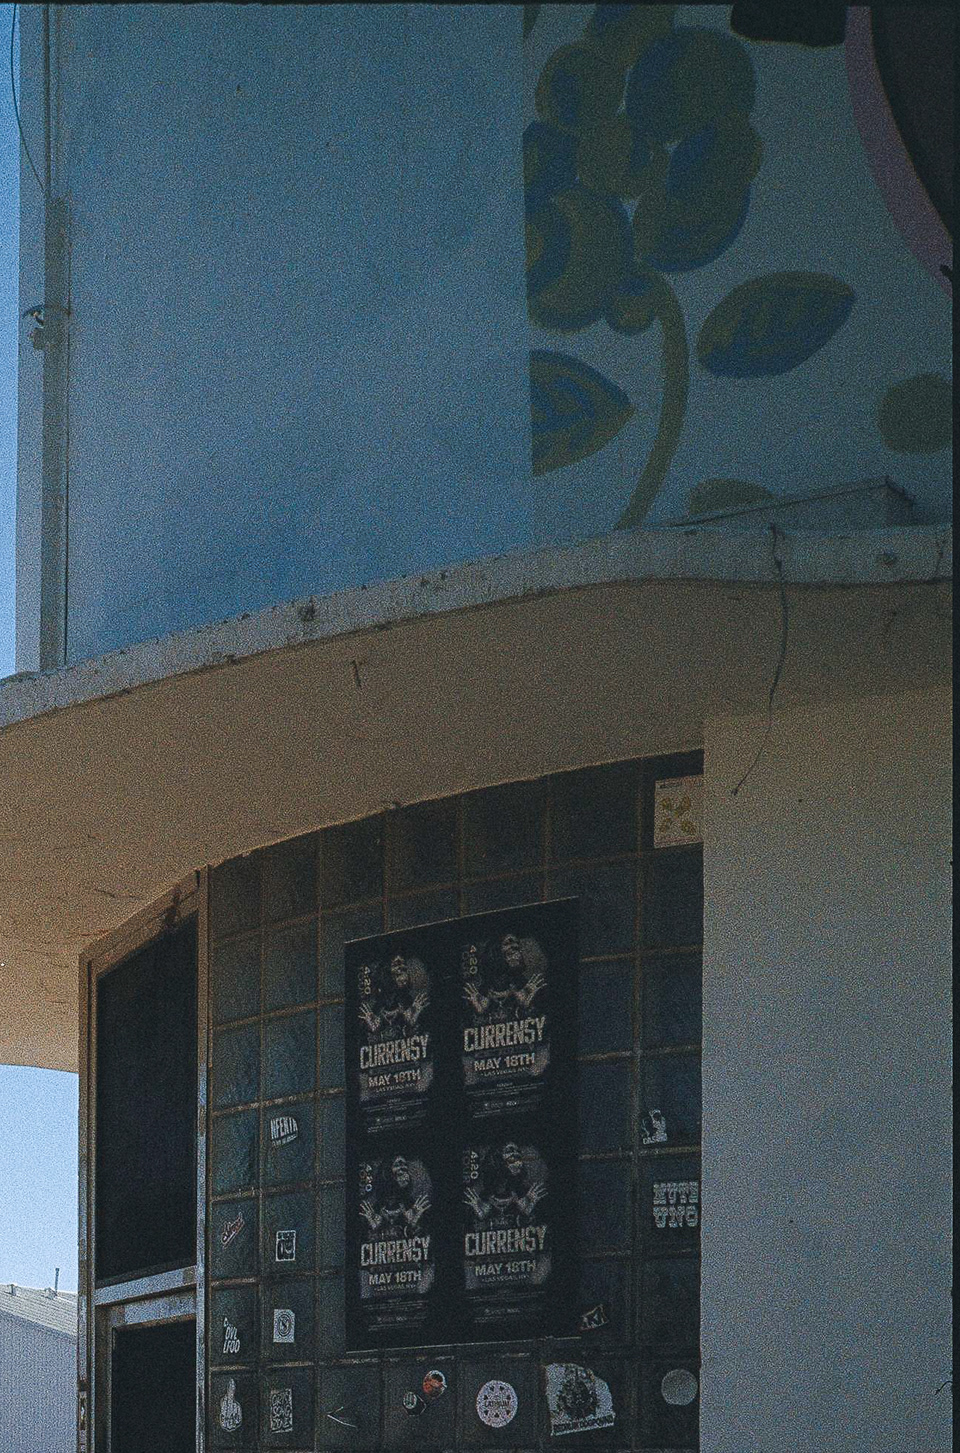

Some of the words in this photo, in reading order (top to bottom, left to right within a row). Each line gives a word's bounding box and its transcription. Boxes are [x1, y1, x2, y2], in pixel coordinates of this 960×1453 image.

[474, 1056, 502, 1072] MAY
[504, 1052, 535, 1068] 18TH
[368, 1073, 391, 1089] MAY
[394, 1068, 422, 1084] 18TH
[653, 1205, 699, 1228] UNO
[368, 1272, 392, 1286] MAY
[395, 1269, 422, 1284] 18TH
[474, 1263, 503, 1277] MAY
[505, 1259, 536, 1274] 18TH
